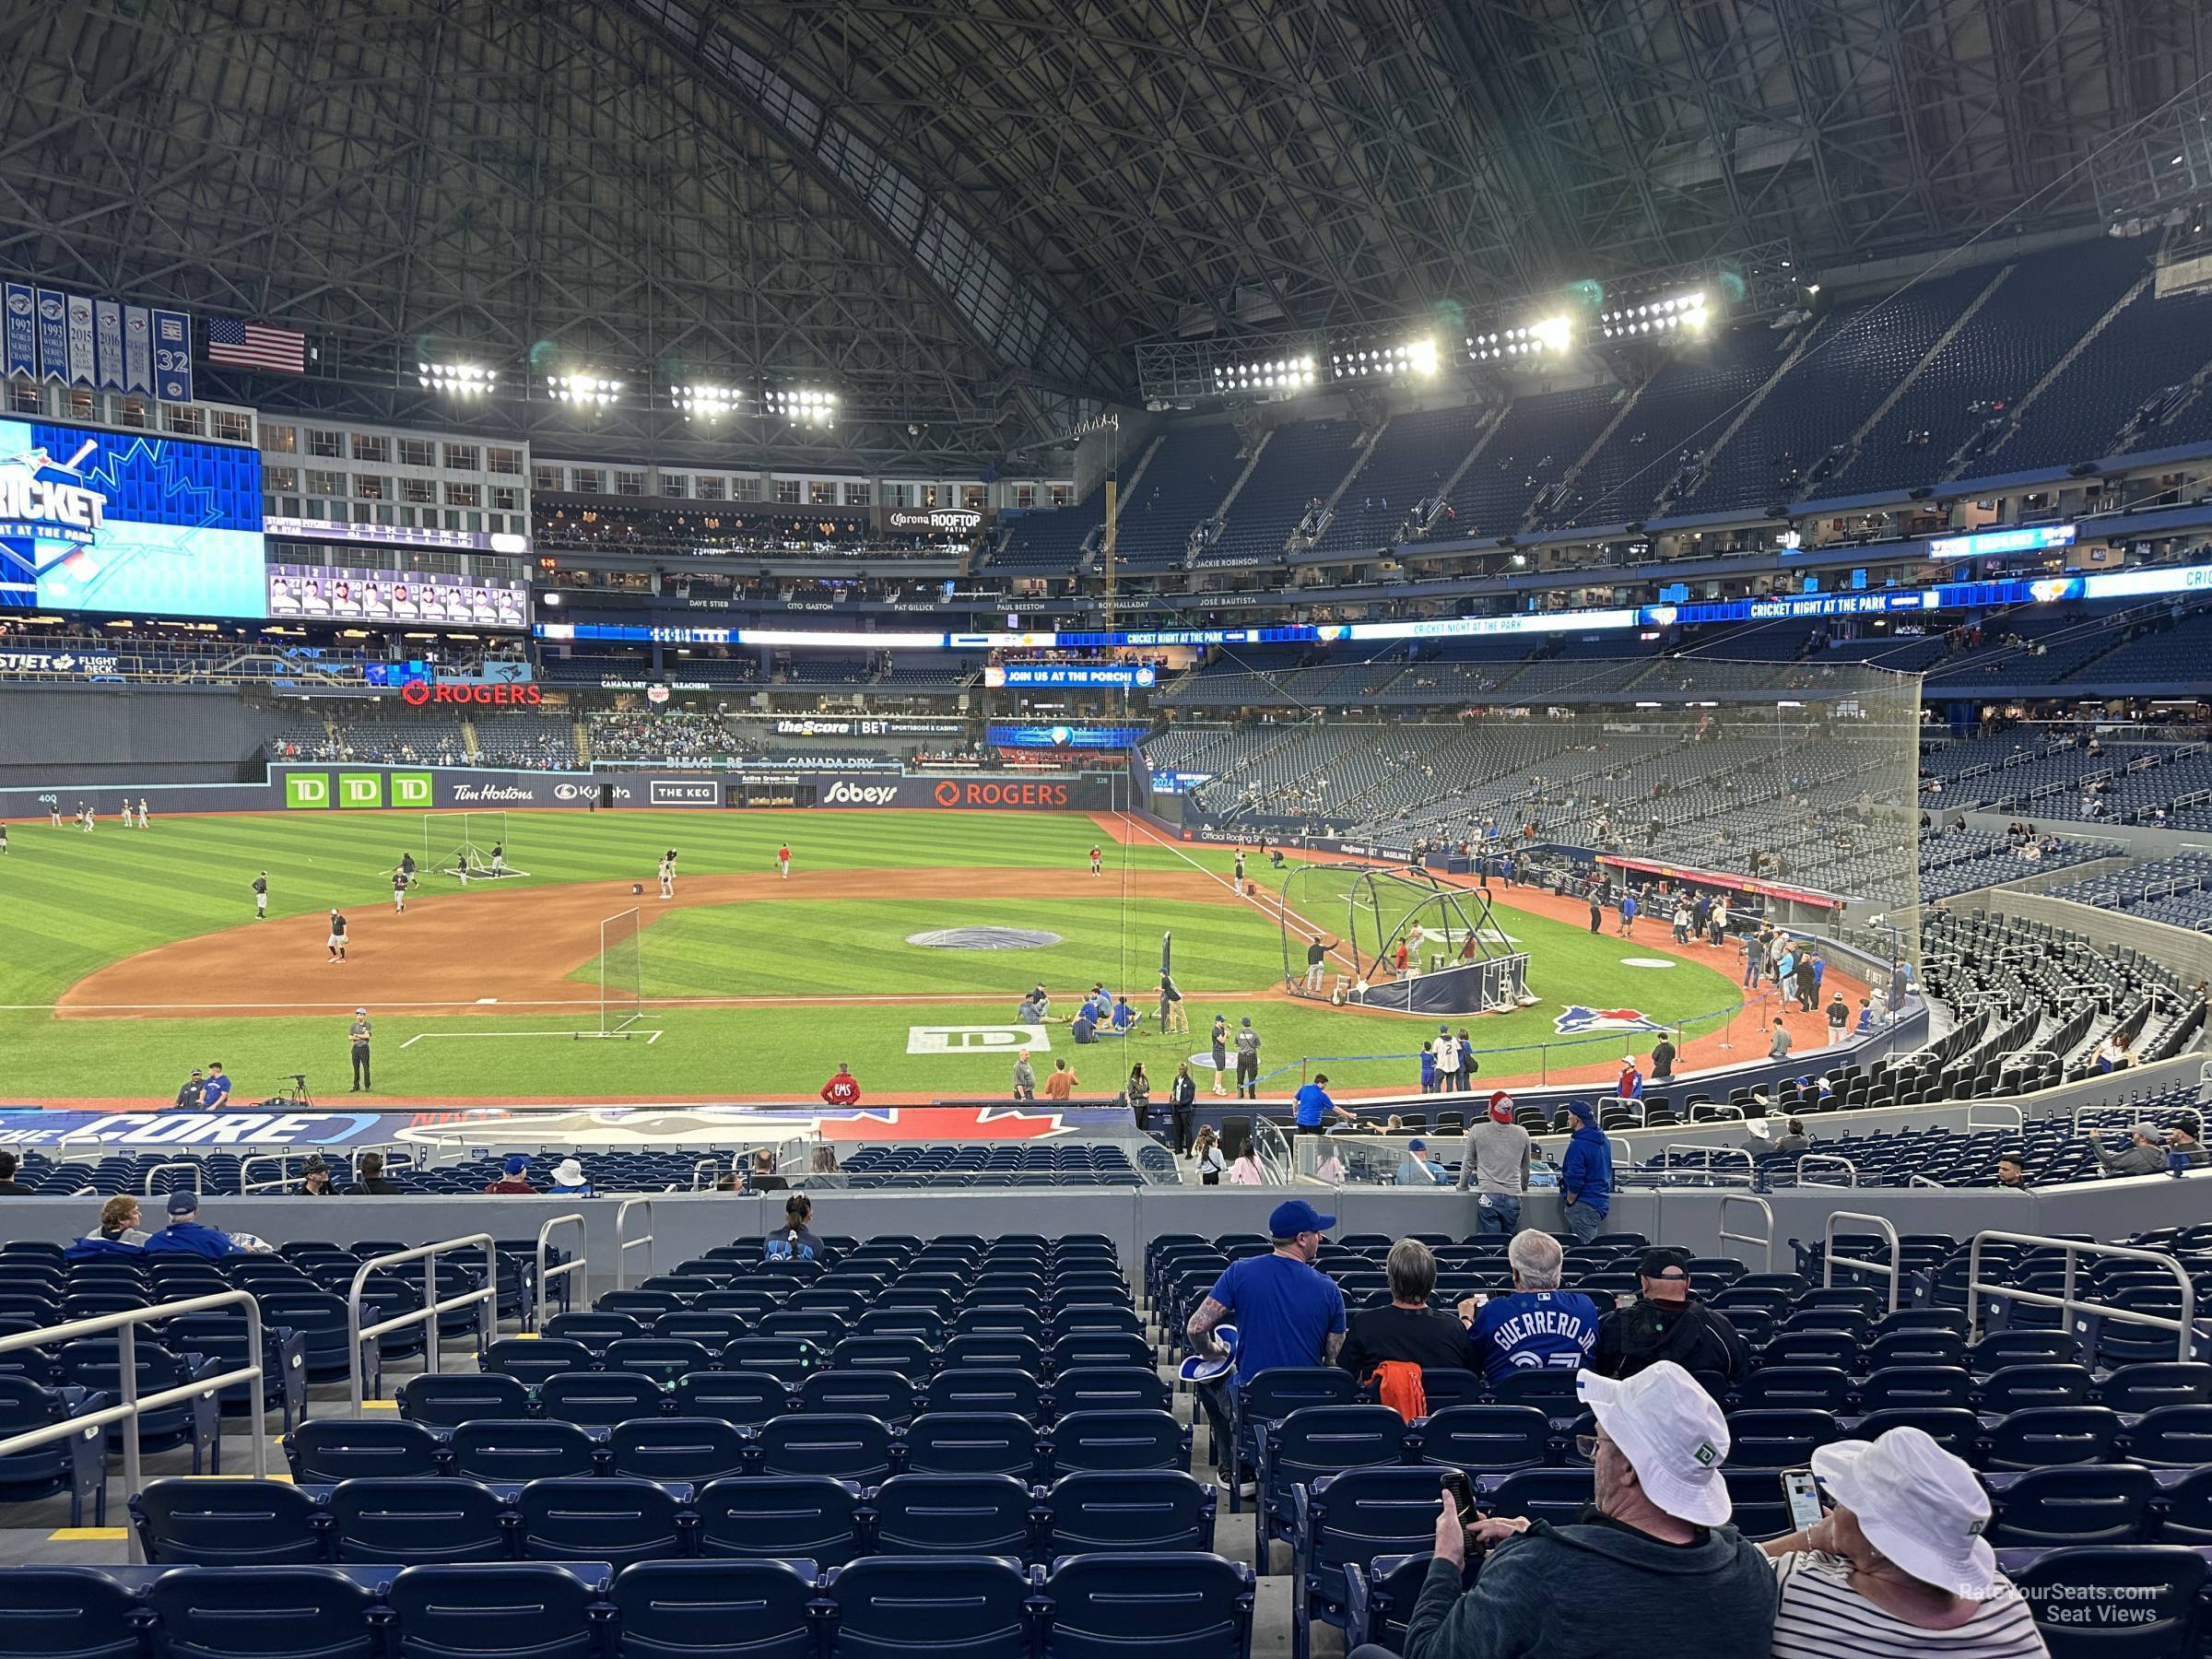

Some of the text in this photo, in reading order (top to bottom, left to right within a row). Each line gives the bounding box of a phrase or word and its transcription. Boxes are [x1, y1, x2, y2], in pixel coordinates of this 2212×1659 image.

[10, 317, 31, 333] 1992
[42, 324, 63, 338] 1993
[11, 332, 31, 342] WORLD
[71, 328, 92, 341] 2015
[100, 333, 120, 346] 2016
[157, 349, 190, 373] 32
[890, 513, 981, 527] Corona ROOFTOP
[37, 526, 61, 538] THE
[1196, 558, 1258, 569] JACKIE ROBINSON
[1200, 596, 1257, 606] JOSÉ BAUTISTA
[1751, 603, 1791, 618] CRICKET
[1794, 601, 1822, 615] NIGHT
[1824, 599, 1837, 613] AT
[1838, 598, 1856, 612] THE
[1859, 596, 1887, 610] PARK
[1414, 619, 1523, 635] CRICKET NIGHT AT THE PARK
[1127, 633, 1156, 644] CRICKET
[1158, 632, 1181, 643] NIGHT
[1181, 632, 1190, 642] AT
[1190, 632, 1204, 642] THE
[1205, 631, 1223, 642] PARK
[79, 656, 118, 665] FLIGHT
[85, 665, 112, 674] DECK
[1008, 671, 1132, 682] JOIN US AT THE PORCH!
[437, 684, 542, 705] ROGERS
[778, 720, 850, 734] theScore
[862, 721, 888, 734] BET
[787, 758, 875, 769] CANADA DRY
[395, 779, 428, 800] TD
[1152, 778, 1174, 787] 2024
[289, 780, 324, 801] TD
[343, 780, 377, 801] TD
[453, 784, 534, 801] Tim Hortons
[658, 788, 710, 797] THE KEG
[824, 782, 897, 806] Sobeys
[967, 784, 1068, 806] ROGERS
[38, 794, 57, 803] 400
[1201, 831, 1224, 841] Official
[1227, 833, 1252, 844] Roofing
[924, 1030, 1031, 1047] TD
[1445, 1044, 1453, 1055] 2
[834, 1083, 852, 1097] EMS
[56, 1113, 338, 1144] CORE
[1493, 1311, 1581, 1351] GUERRERO
[1700, 1445, 1713, 1461] TD
